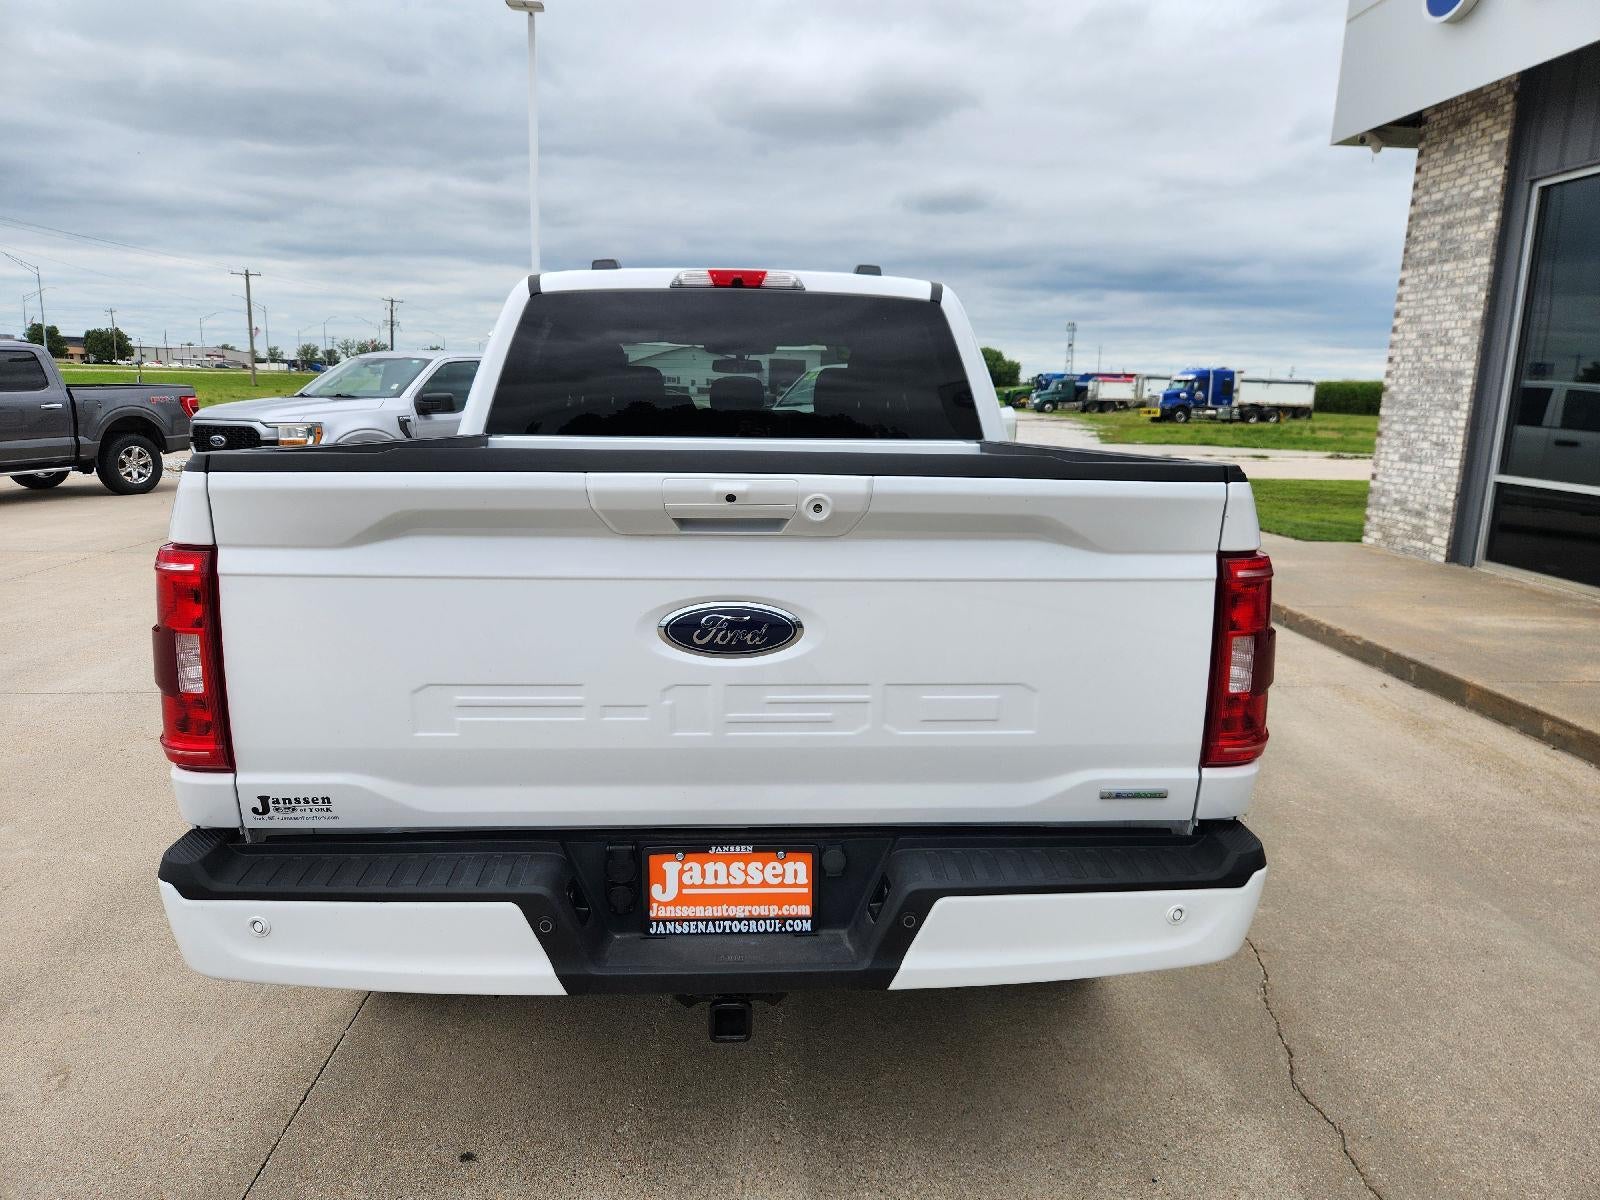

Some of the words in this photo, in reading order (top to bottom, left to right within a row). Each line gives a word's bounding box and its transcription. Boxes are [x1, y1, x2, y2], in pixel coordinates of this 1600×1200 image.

[692, 614, 769, 645] Ford
[411, 683, 1038, 737] F-150
[251, 795, 332, 815] Janssen
[709, 845, 753, 854] JANSSEN
[651, 861, 808, 902] Janssen
[650, 903, 811, 918] Janssenautogroup.com
[650, 919, 812, 934] JANSSENAUTOGROUP.COM
